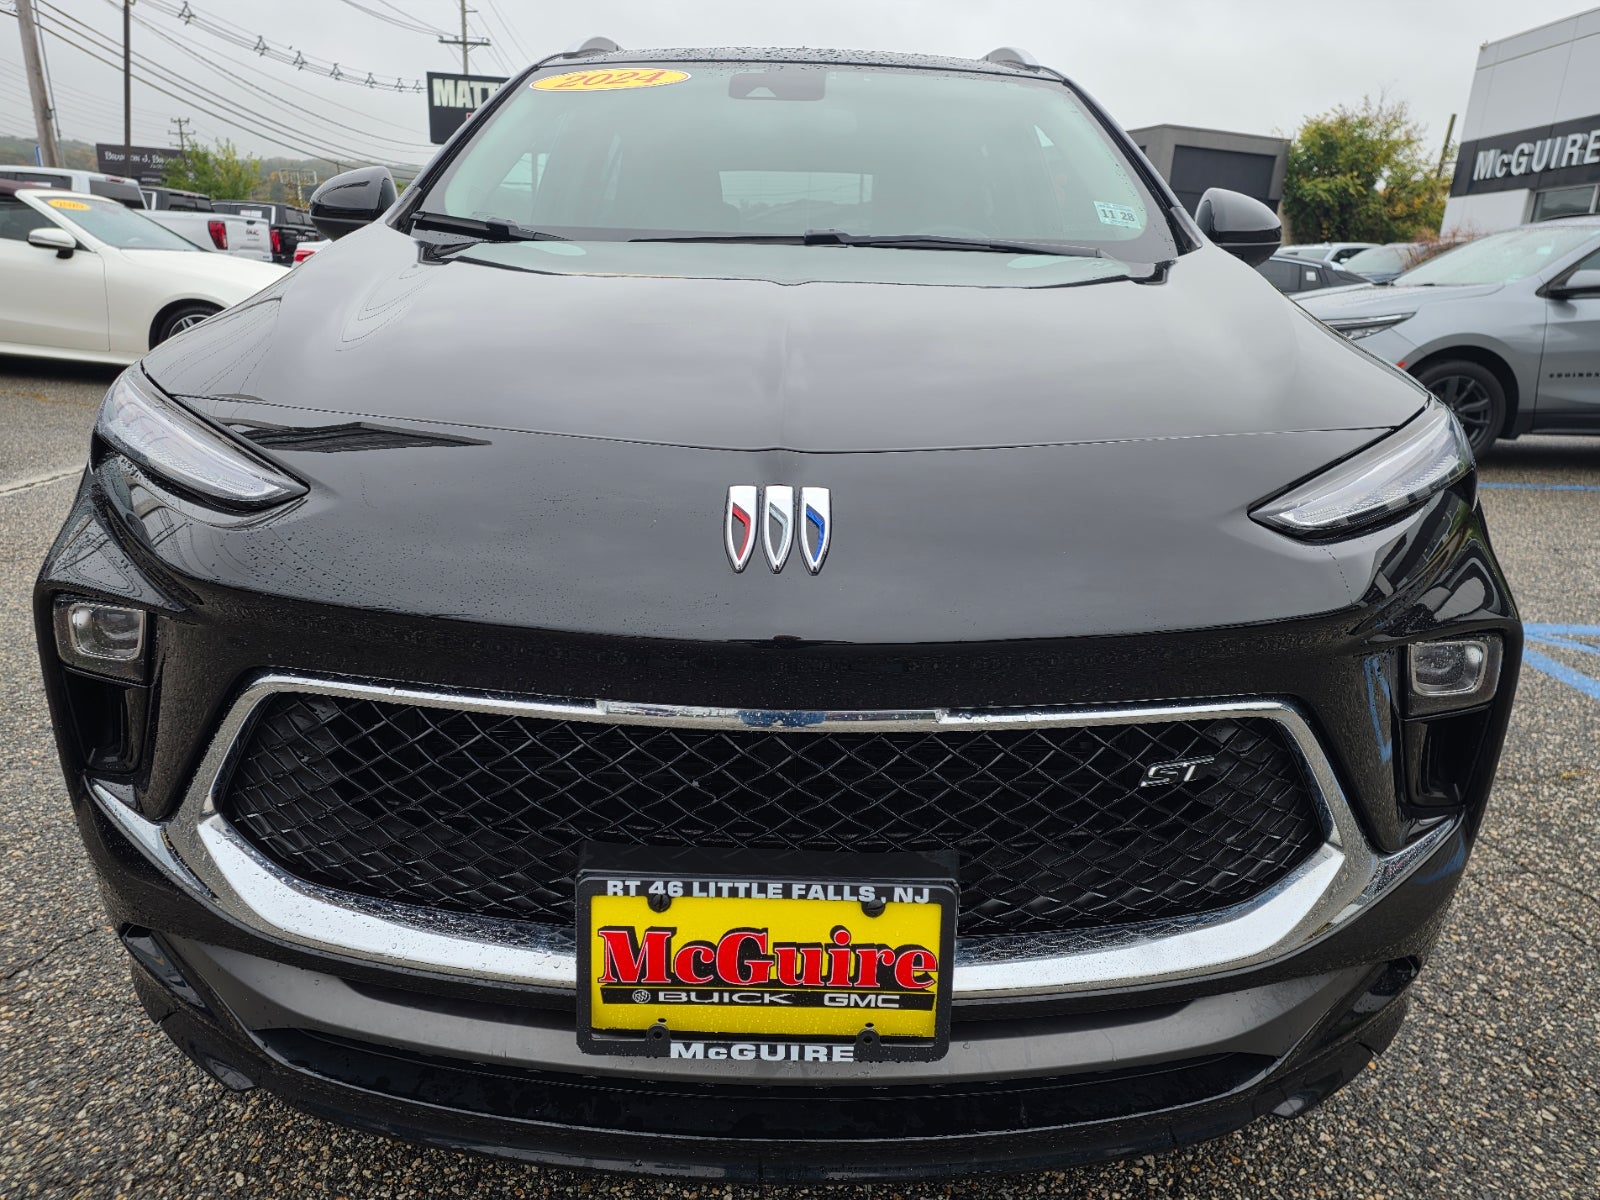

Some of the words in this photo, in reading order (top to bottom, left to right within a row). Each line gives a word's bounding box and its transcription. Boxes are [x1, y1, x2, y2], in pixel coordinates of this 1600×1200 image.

[554, 71, 666, 88] 2024
[432, 78, 505, 109] MATT
[1473, 129, 1600, 181] McGUIRE
[1101, 209, 1116, 219] 11
[1119, 211, 1135, 222] 28
[1140, 756, 1214, 787] ST
[607, 880, 641, 897] RT
[648, 881, 684, 897] 46
[692, 881, 783, 899] LITTLE
[893, 887, 930, 904] NJ
[598, 926, 938, 989] McGuire
[658, 991, 794, 1004] BUICK
[823, 993, 900, 1008] GMC
[670, 1042, 855, 1062] McGUIRE
